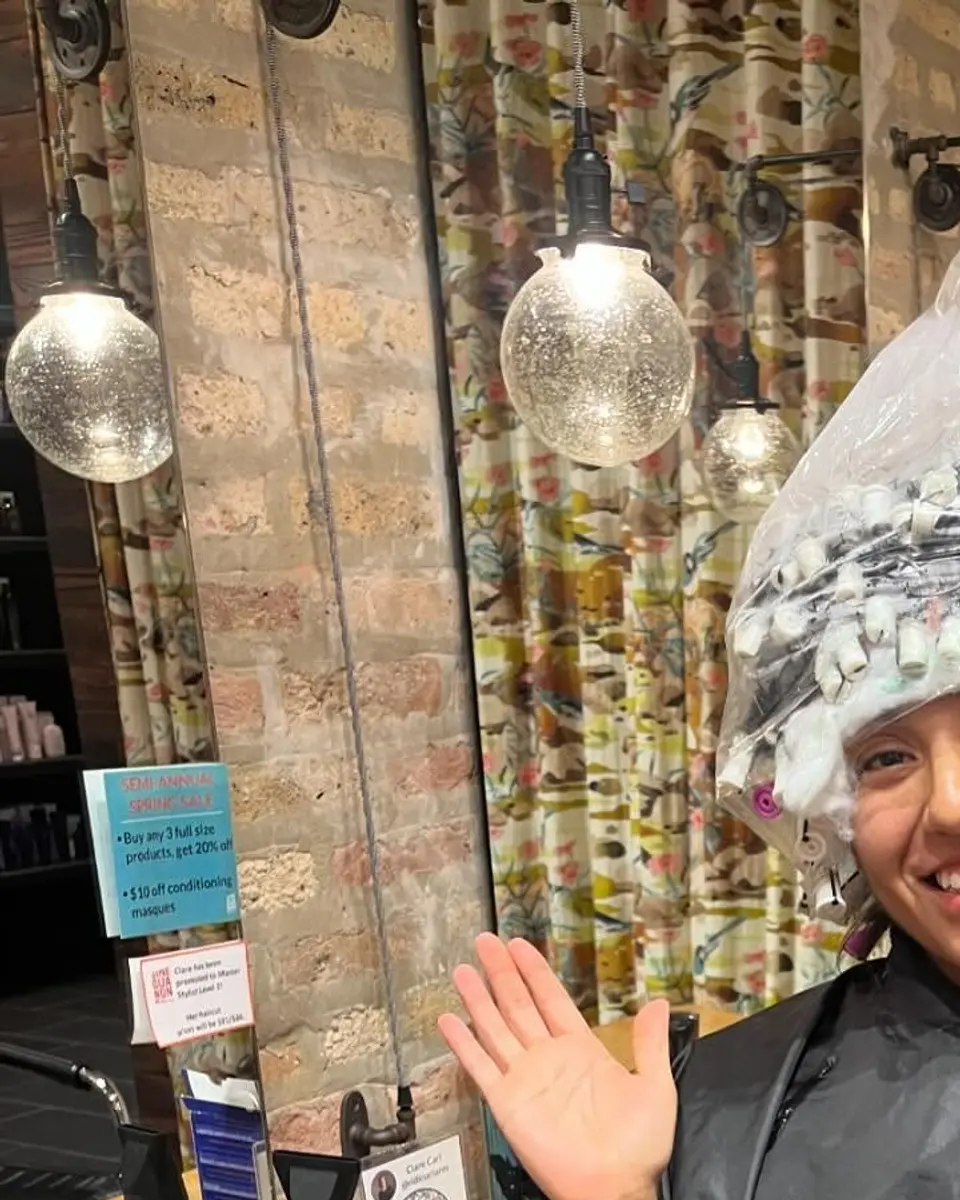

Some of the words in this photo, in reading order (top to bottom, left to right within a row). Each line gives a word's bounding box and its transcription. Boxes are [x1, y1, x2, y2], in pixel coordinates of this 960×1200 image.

[181, 792, 212, 809] SALE
[124, 831, 144, 846] Buy
[146, 830, 163, 844] any
[166, 827, 173, 839] 3
[175, 825, 193, 839] full
[195, 824, 216, 836] size
[126, 847, 175, 866] products,
[176, 844, 193, 860] get
[195, 841, 218, 855] 20%
[220, 839, 233, 851] off
[130, 886, 150, 901] $10
[151, 883, 166, 897] off
[167, 875, 233, 895] conditioning
[132, 902, 176, 919] masques
